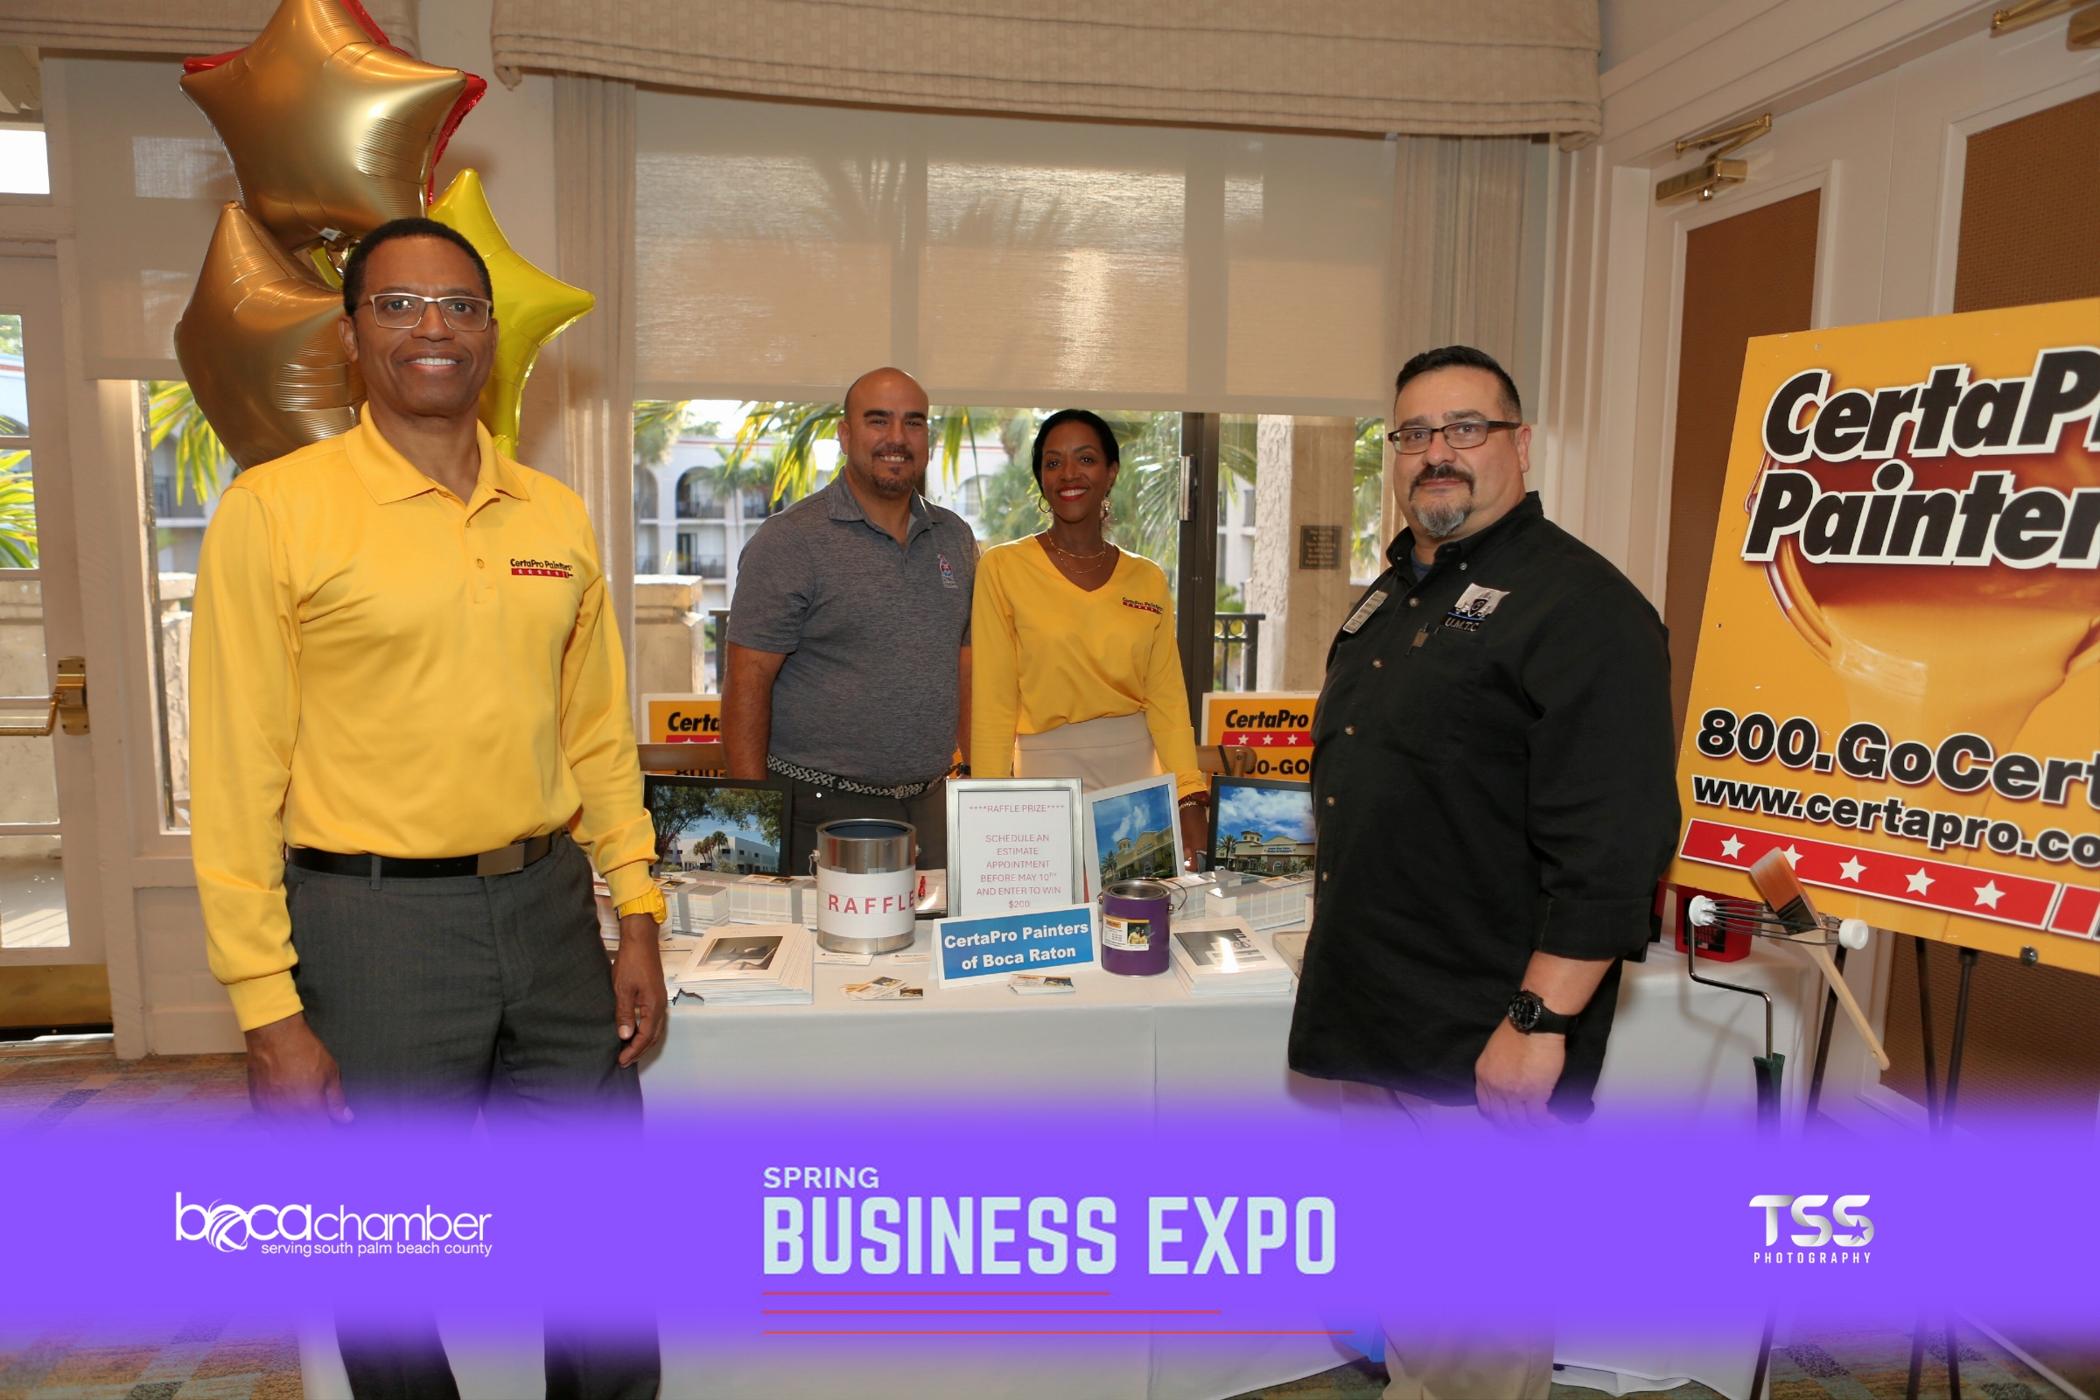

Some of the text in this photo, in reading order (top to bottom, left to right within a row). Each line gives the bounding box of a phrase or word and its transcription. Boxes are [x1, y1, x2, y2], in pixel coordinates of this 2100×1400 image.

[1762, 346, 2100, 463] CertaP
[510, 558, 544, 568] CertaPro
[667, 711, 720, 732] Certa
[1225, 709, 1309, 728] CertaPro
[985, 833, 1050, 843] SCHEDULE AN
[997, 847, 1039, 856] ESTIMATE
[986, 859, 1050, 869] APPOINTMENT
[980, 873, 1016, 883] BEFORE
[1018, 873, 1036, 882] MAY
[976, 886, 1061, 896] AND ENTER TO WIN
[828, 889, 914, 914] RAFFLE
[1008, 900, 1030, 909] $200
[944, 930, 1018, 949] CertaPro
[1022, 923, 1089, 940] Painters
[961, 946, 1076, 970] of Boca Raton
